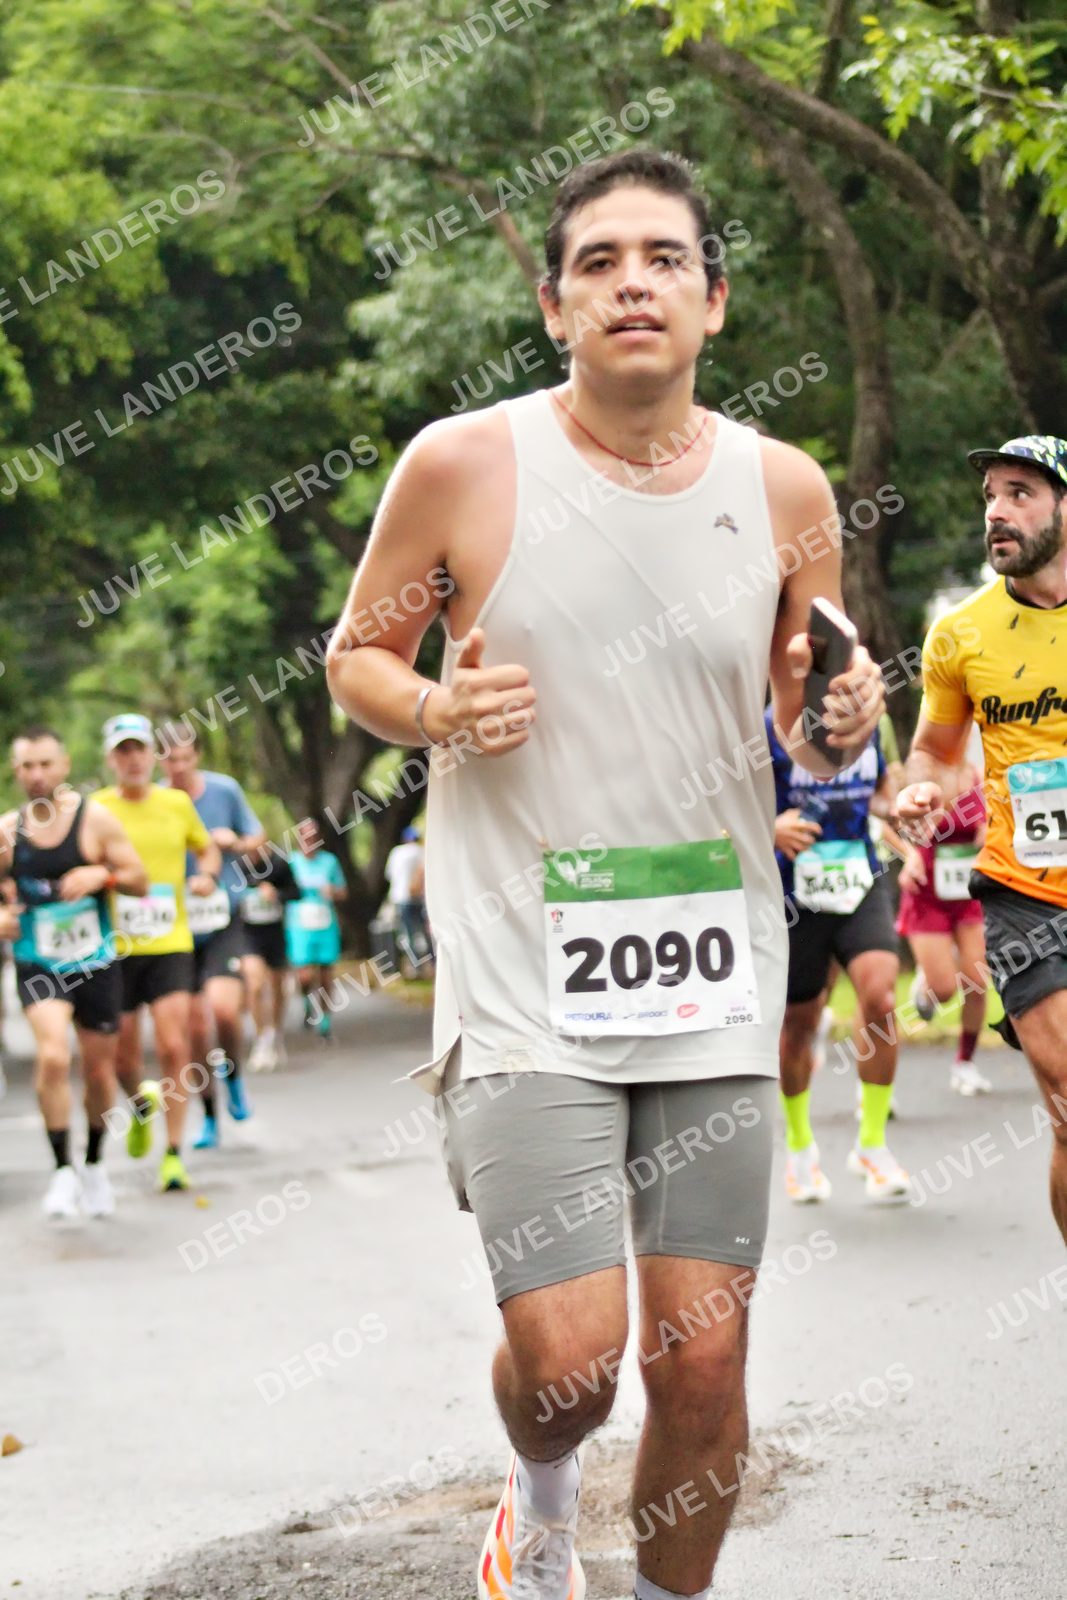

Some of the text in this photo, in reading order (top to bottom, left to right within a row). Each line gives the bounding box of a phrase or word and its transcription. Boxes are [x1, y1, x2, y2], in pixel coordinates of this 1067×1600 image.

[981, 686, 1067, 725] Runfr
[561, 926, 735, 994] 2090
[725, 1013, 753, 1026] 2090
